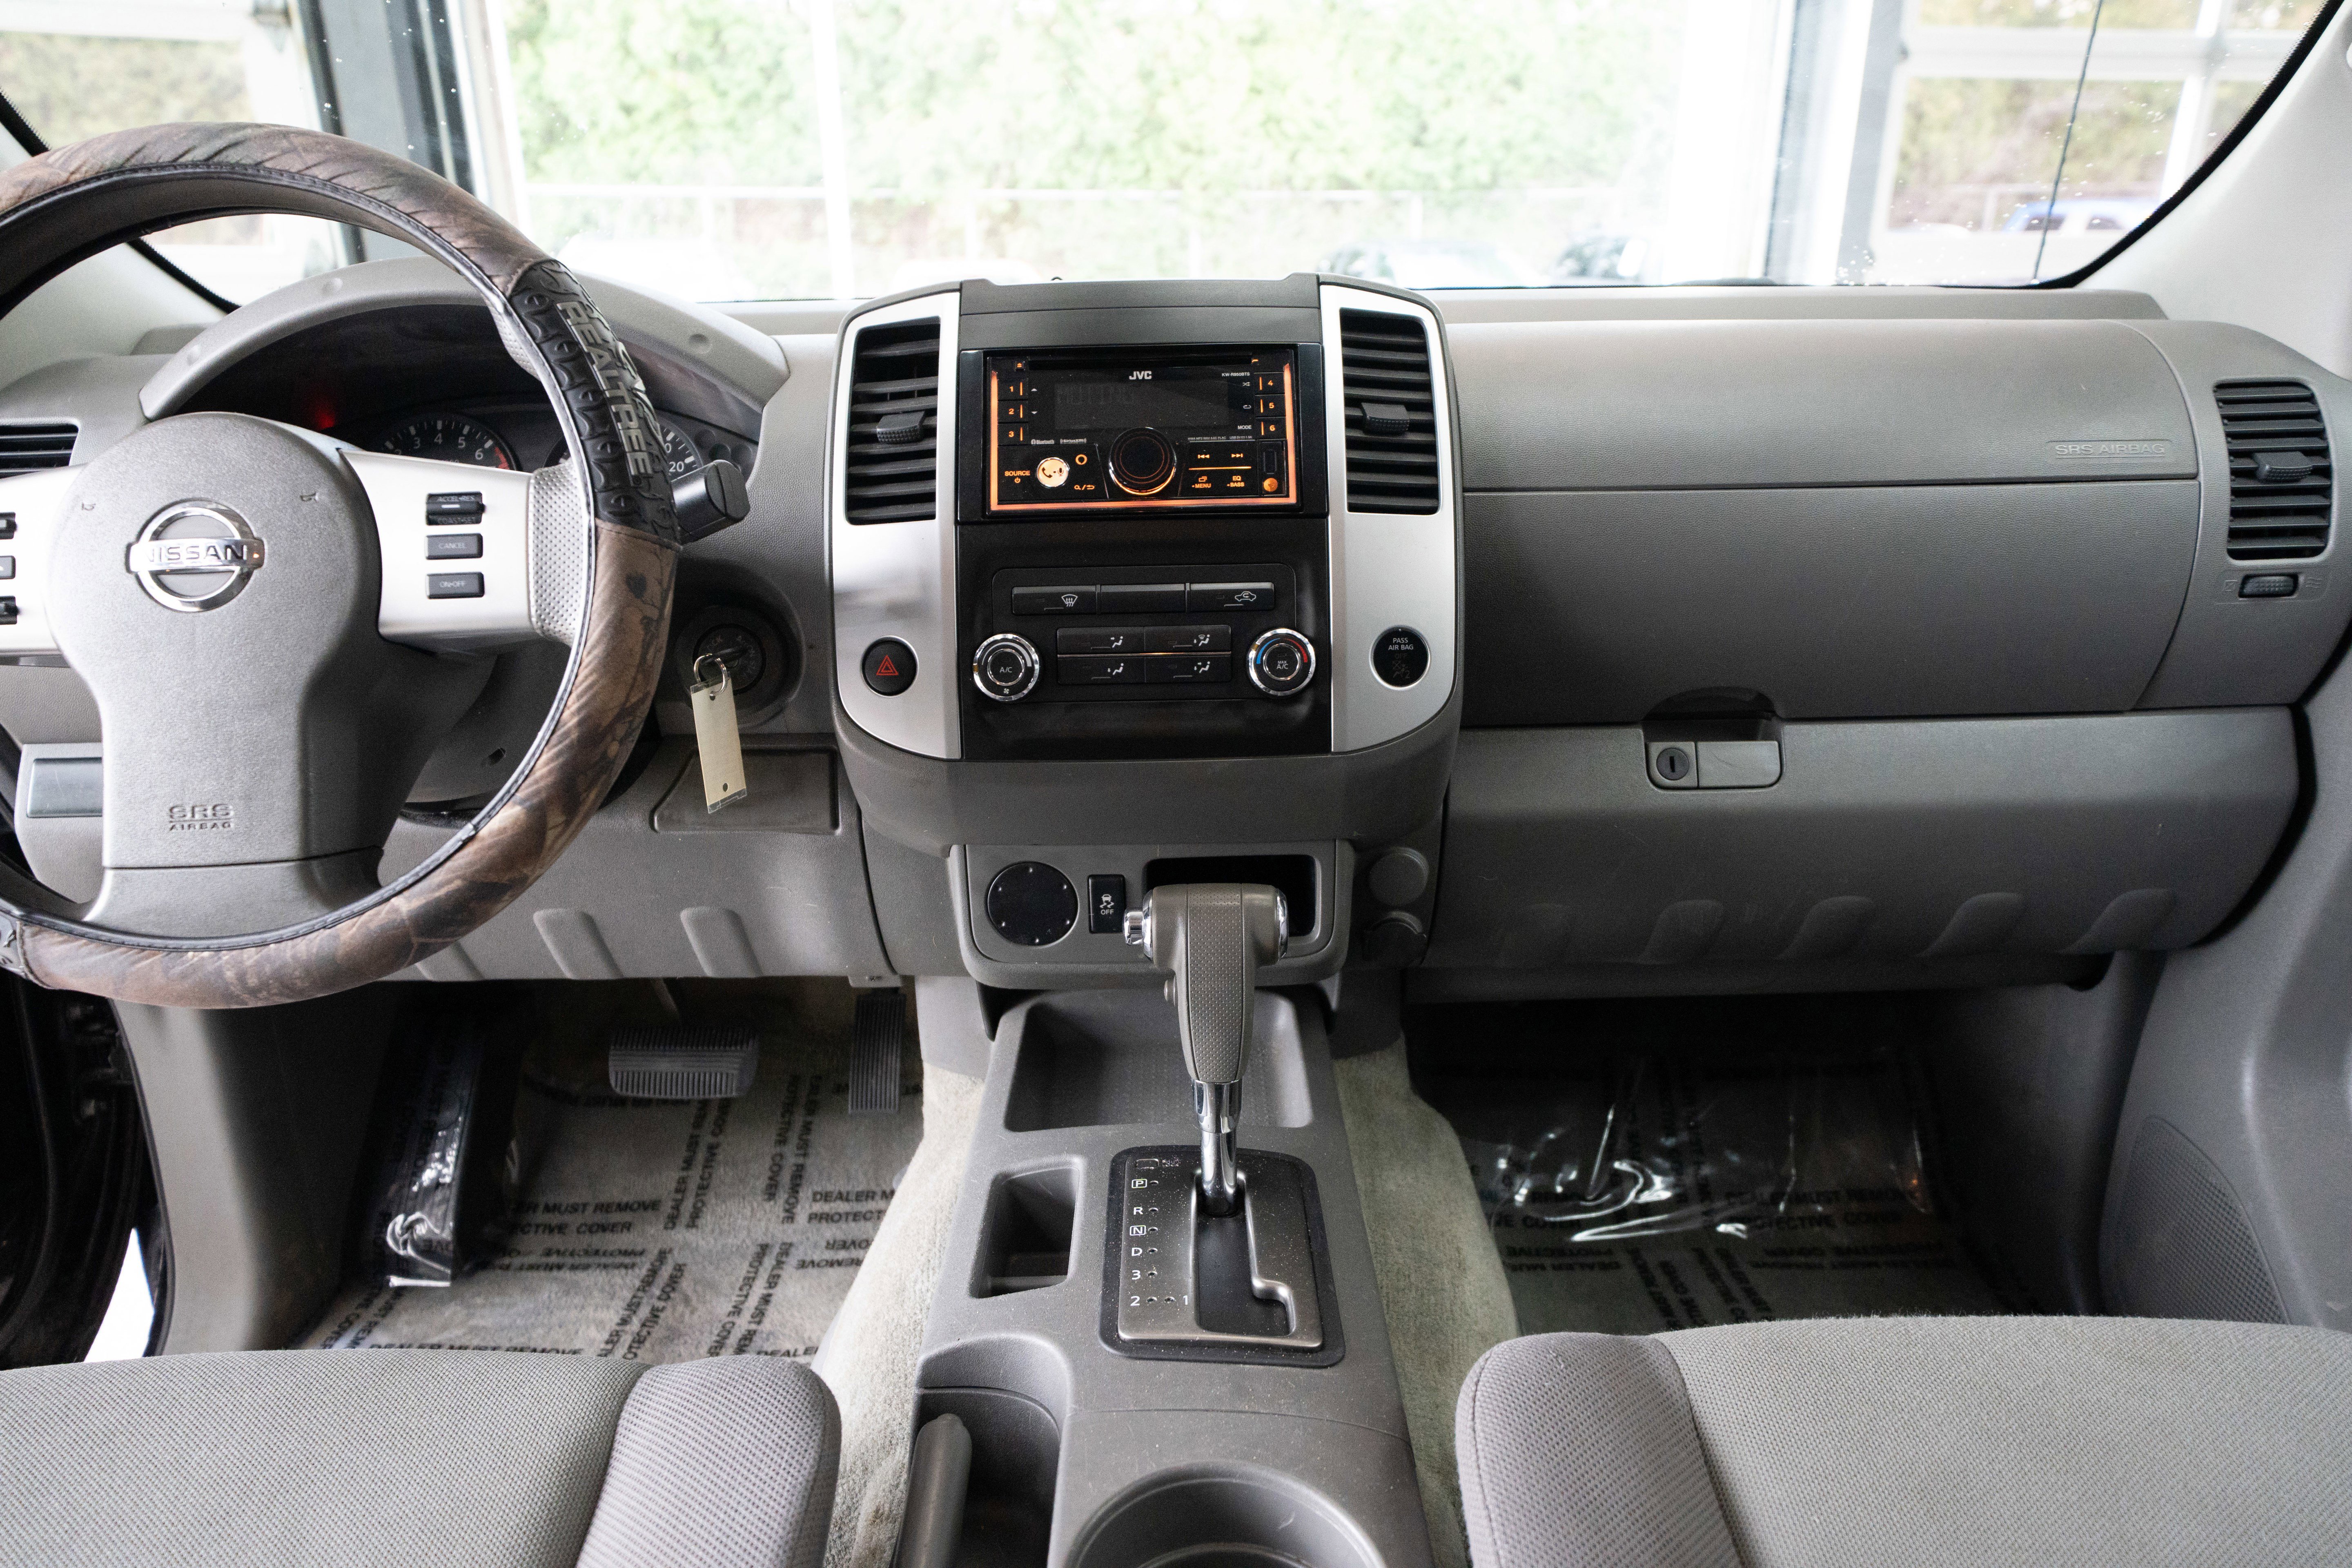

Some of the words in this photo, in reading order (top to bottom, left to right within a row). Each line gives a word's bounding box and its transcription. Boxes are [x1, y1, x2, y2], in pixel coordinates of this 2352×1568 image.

[1129, 371, 1152, 380] JVC
[556, 301, 654, 475] REALTREE
[414, 437, 421, 449] 3
[434, 433, 442, 444] 4
[458, 437, 466, 448] 5
[475, 448, 483, 460] 6
[2056, 444, 2093, 455] SRS
[2097, 443, 2165, 455] AIRBAG
[145, 544, 247, 563] NISSAN
[168, 803, 233, 819] SRS
[168, 821, 232, 832] AIRBAG
[812, 1190, 876, 1203] DEALER
[592, 1199, 662, 1213] REMOVE
[1133, 1207, 1143, 1215] R
[807, 1210, 886, 1224] PROTECT
[576, 1222, 633, 1234] COVER
[825, 1238, 873, 1250] OVER
[1131, 1247, 1143, 1256] D
[764, 1242, 793, 1290] DEALER
[727, 1243, 771, 1318] PROTECTIVE
[1131, 1270, 1141, 1279] 3
[1130, 1296, 1140, 1305] 2
[1183, 1295, 1188, 1305] 1
[748, 1293, 773, 1326] MUST
[622, 1305, 667, 1360] OTECTIVE
